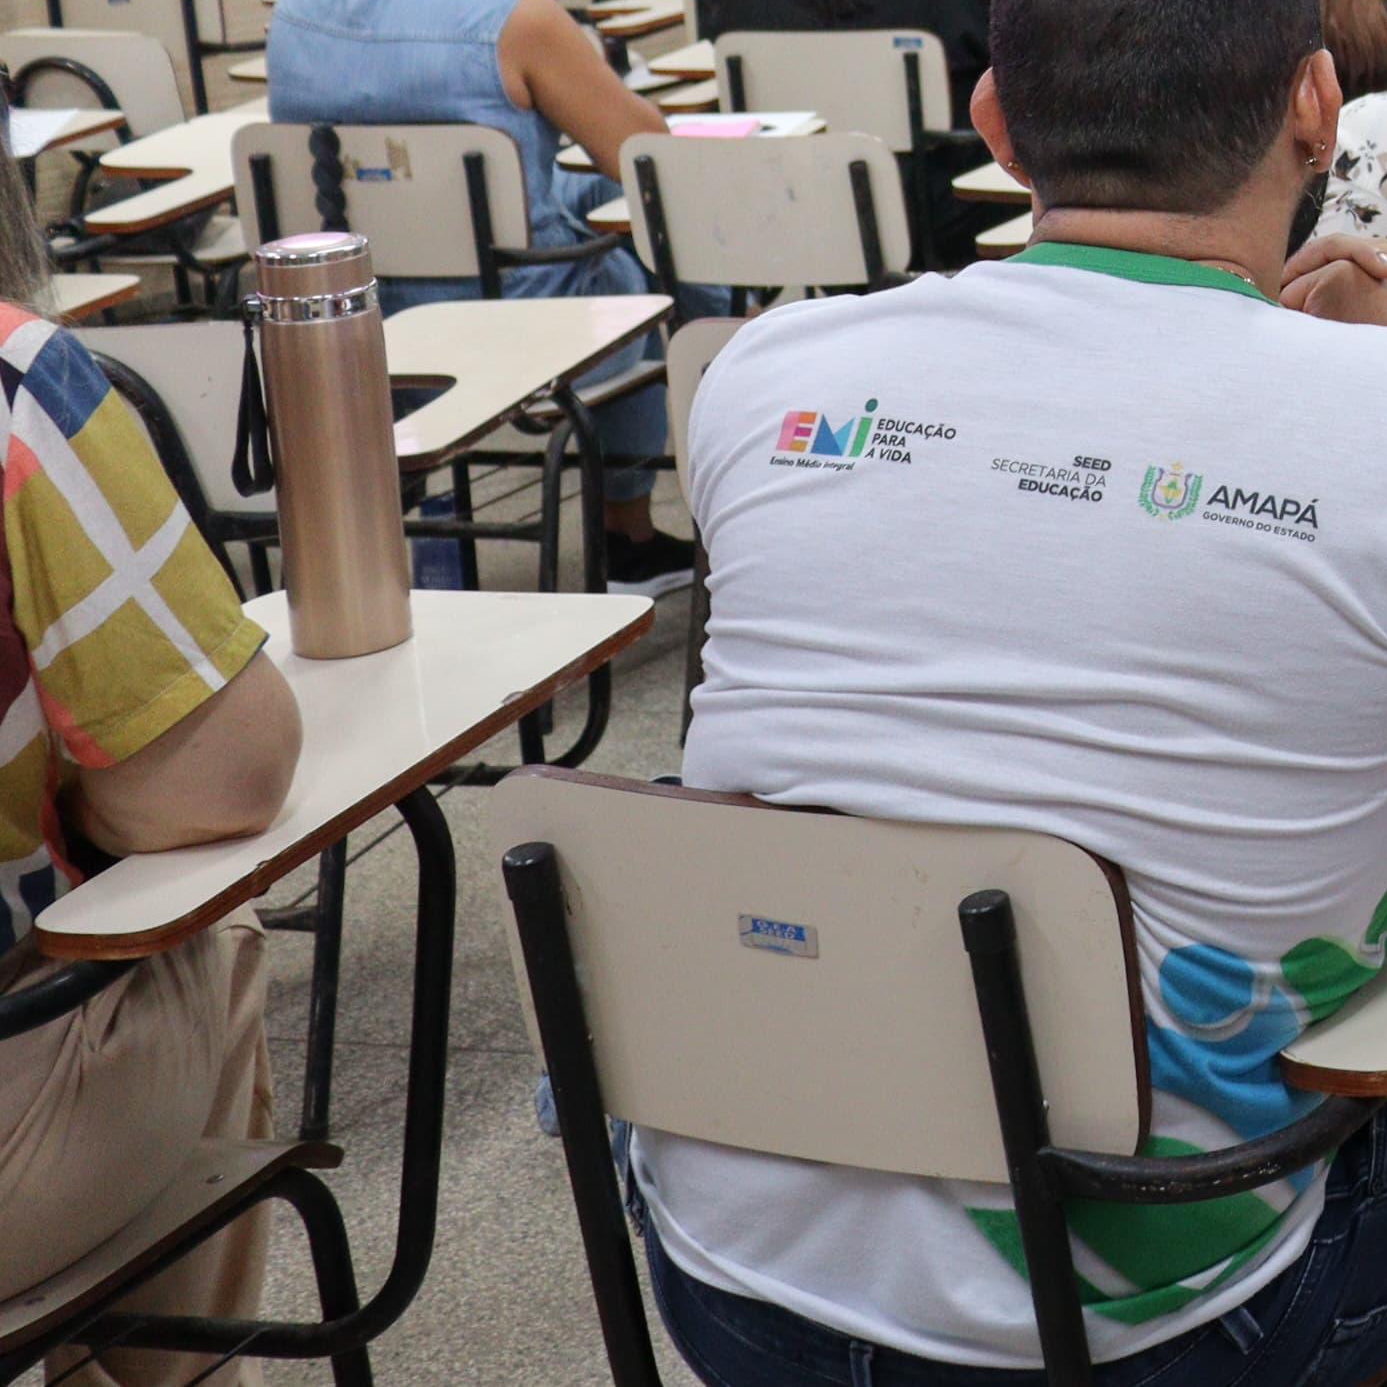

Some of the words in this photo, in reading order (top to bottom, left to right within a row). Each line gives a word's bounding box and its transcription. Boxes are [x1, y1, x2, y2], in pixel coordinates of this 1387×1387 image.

[877, 418, 957, 440] EDUCAÇÃO
[871, 433, 907, 448] PARA
[769, 456, 794, 467] Ensino
[864, 448, 874, 459] A
[879, 448, 912, 464] VIDA
[1073, 455, 1112, 471] SEED
[990, 458, 1080, 484] SECRETARIA
[1085, 473, 1107, 487] DA
[1018, 478, 1103, 502] EDUCAÇÃO
[1206, 485, 1320, 529] AMAPÁ
[1202, 511, 1254, 529] GOVERNO
[1255, 522, 1272, 532] DO
[1273, 526, 1316, 543] ESTADO
